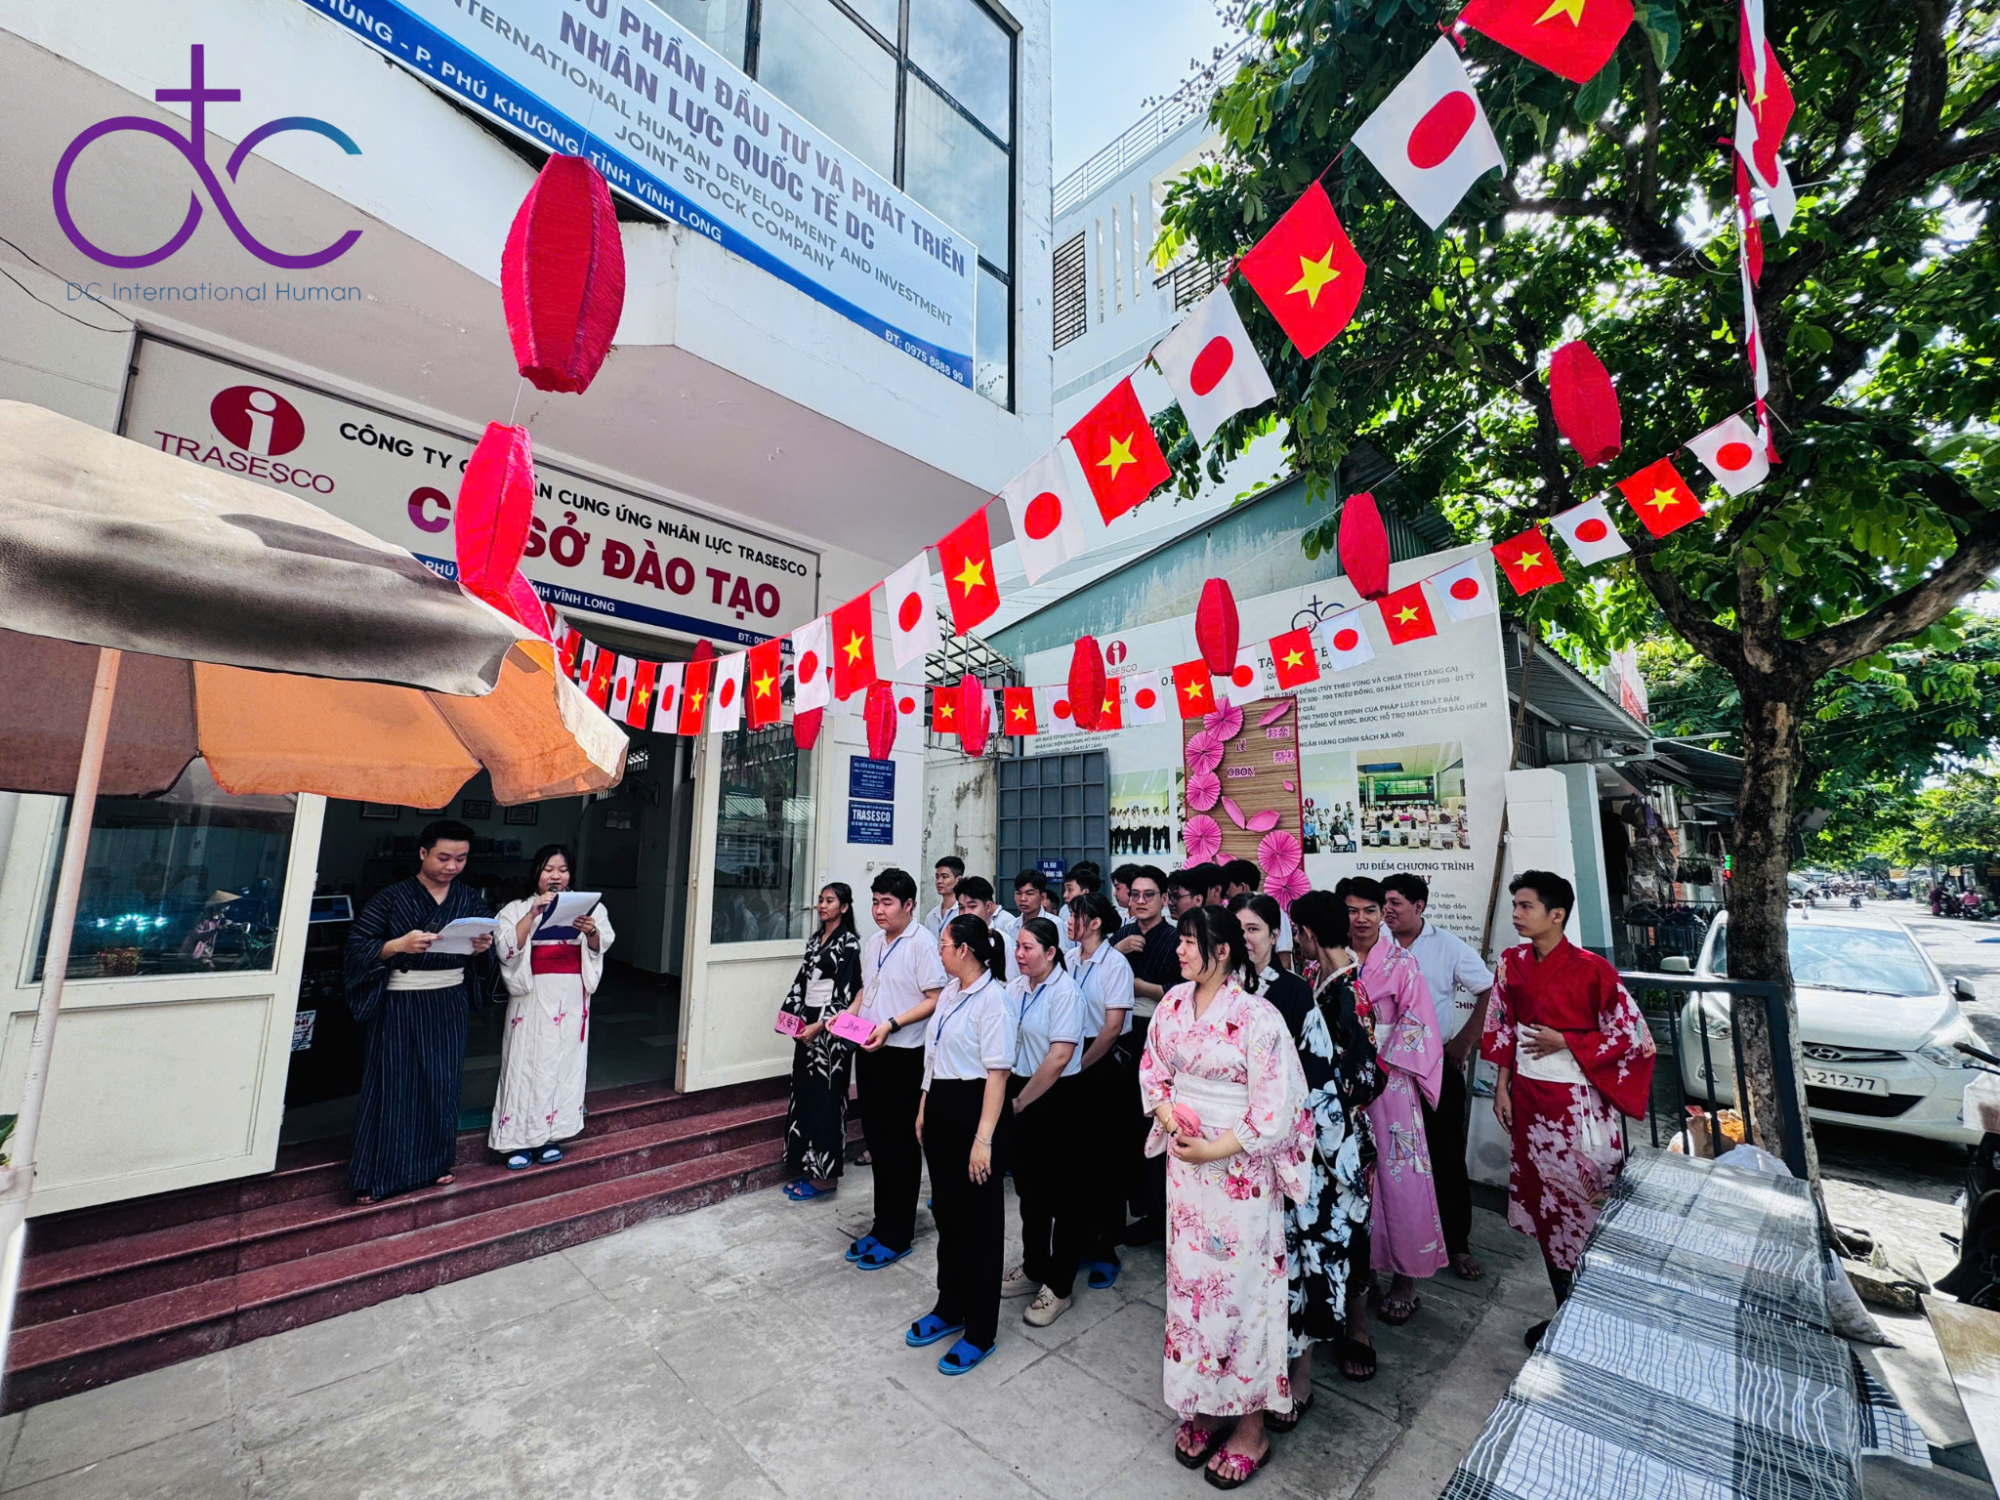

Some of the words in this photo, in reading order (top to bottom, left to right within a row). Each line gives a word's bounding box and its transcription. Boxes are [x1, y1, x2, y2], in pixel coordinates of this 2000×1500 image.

[559, 11, 658, 104] NHÂN
[668, 86, 724, 147] LỰC
[733, 134, 804, 202] QUỐC
[811, 185, 840, 227] TẾ
[846, 210, 875, 250] DC
[619, 6, 706, 93] PHẦN
[715, 76, 770, 137] ĐẦU
[778, 122, 811, 165] TƯ
[815, 150, 845, 194] VÀ
[852, 177, 906, 234] PHÁT
[911, 219, 965, 278] TRIỂN
[450, 0, 631, 119] TERNATIONAL
[637, 110, 710, 171] HUMAN
[716, 162, 837, 251] DEVELOPMENT
[840, 246, 871, 274] AND
[875, 267, 952, 327] INVESTMENT
[416, 45, 433, 69] P.
[441, 62, 487, 99] PHÚ
[590, 151, 631, 187] TỈNH
[636, 178, 675, 213] VĨNH
[679, 206, 722, 242] LONG
[904, 341, 928, 362] 0975
[929, 355, 951, 376] 8888
[952, 370, 964, 383] 99
[614, 125, 678, 173] JOINT
[683, 166, 747, 219] STOCK
[752, 211, 835, 272] COMPANY
[154, 430, 335, 494] TRASESCO
[340, 423, 414, 458] CÔNG
[423, 446, 453, 469] TY
[558, 489, 610, 517] CUNG
[616, 503, 652, 530] ỨNG
[658, 520, 700, 545] NHÂN
[705, 534, 733, 556] LỰC
[737, 544, 808, 577] TRASESCO
[407, 486, 456, 534] C
[601, 537, 696, 596] ĐÀO
[706, 566, 781, 620] TẠO
[425, 559, 454, 577] PHÚ
[553, 588, 581, 605] VĨNH
[584, 597, 616, 613] LONG
[1106, 663, 1138, 677] ASESCO
[1333, 682, 1351, 690] THEO
[1371, 676, 1381, 684] VÀ
[1404, 671, 1421, 680] TÍNH
[1312, 712, 1329, 720] THEO
[1330, 710, 1343, 718] QUY
[1227, 767, 1254, 776] OBON
[852, 809, 891, 822] TRASESCO
[1356, 862, 1369, 870] ƯU
[1371, 859, 1395, 871] ĐIỂM
[1396, 862, 1439, 871] CHƯƠNG
[1441, 860, 1475, 871] TRÌNH
[1803, 1069, 1876, 1091] A-212.77
